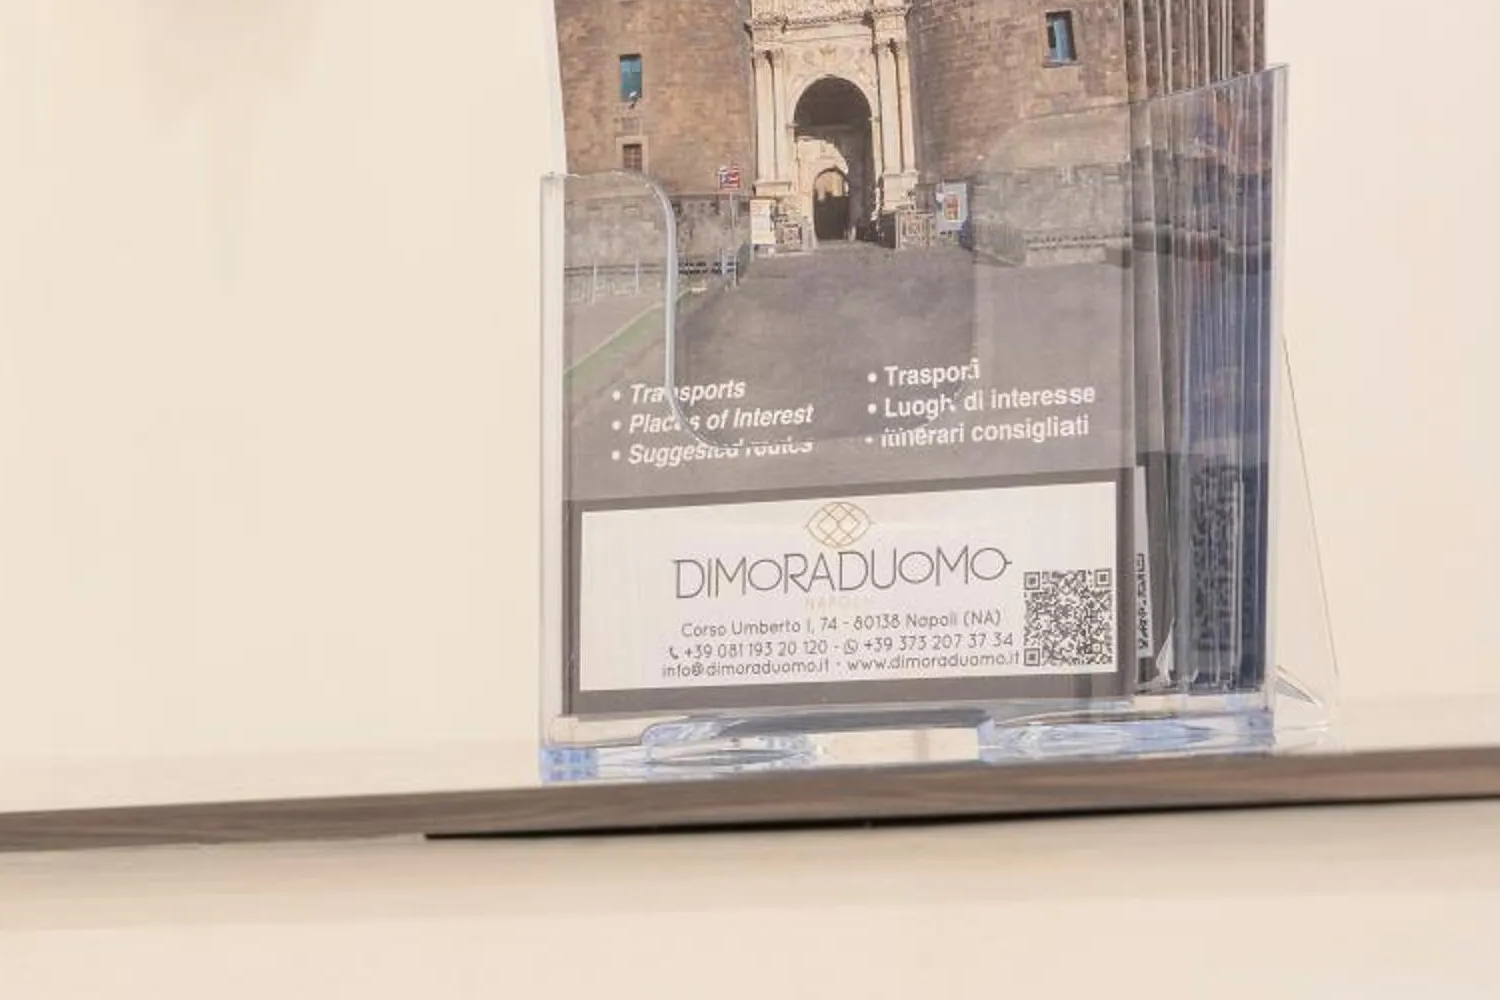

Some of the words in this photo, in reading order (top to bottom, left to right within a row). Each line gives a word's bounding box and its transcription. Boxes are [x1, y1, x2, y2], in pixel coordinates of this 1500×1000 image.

[629, 379, 747, 407] Trasports
[884, 393, 957, 421] Luogh
[963, 389, 985, 412] di
[991, 385, 1097, 410] interesse
[706, 408, 730, 430] of
[733, 402, 815, 429] Interest
[971, 414, 1090, 444] consigliati
[672, 544, 1013, 600] DIMORADUOMO
[681, 622, 727, 638] Corso
[731, 618, 802, 636] Umberto
[820, 616, 838, 631] 74
[853, 612, 901, 631] 80138
[905, 611, 958, 630] Napoli
[963, 608, 1002, 628] (NA)
[684, 643, 713, 659] +39
[717, 642, 744, 659] 081
[748, 641, 773, 657] 193
[778, 640, 797, 657] 20
[803, 639, 829, 656] 120
[863, 636, 893, 653] +39
[899, 634, 928, 651] 373
[931, 633, 963, 650] 207
[967, 632, 988, 649] 37
[992, 631, 1014, 648] 34
[661, 657, 830, 679] info@dimoraduomo.it
[846, 650, 1021, 672] www.dimoraduomo.it
